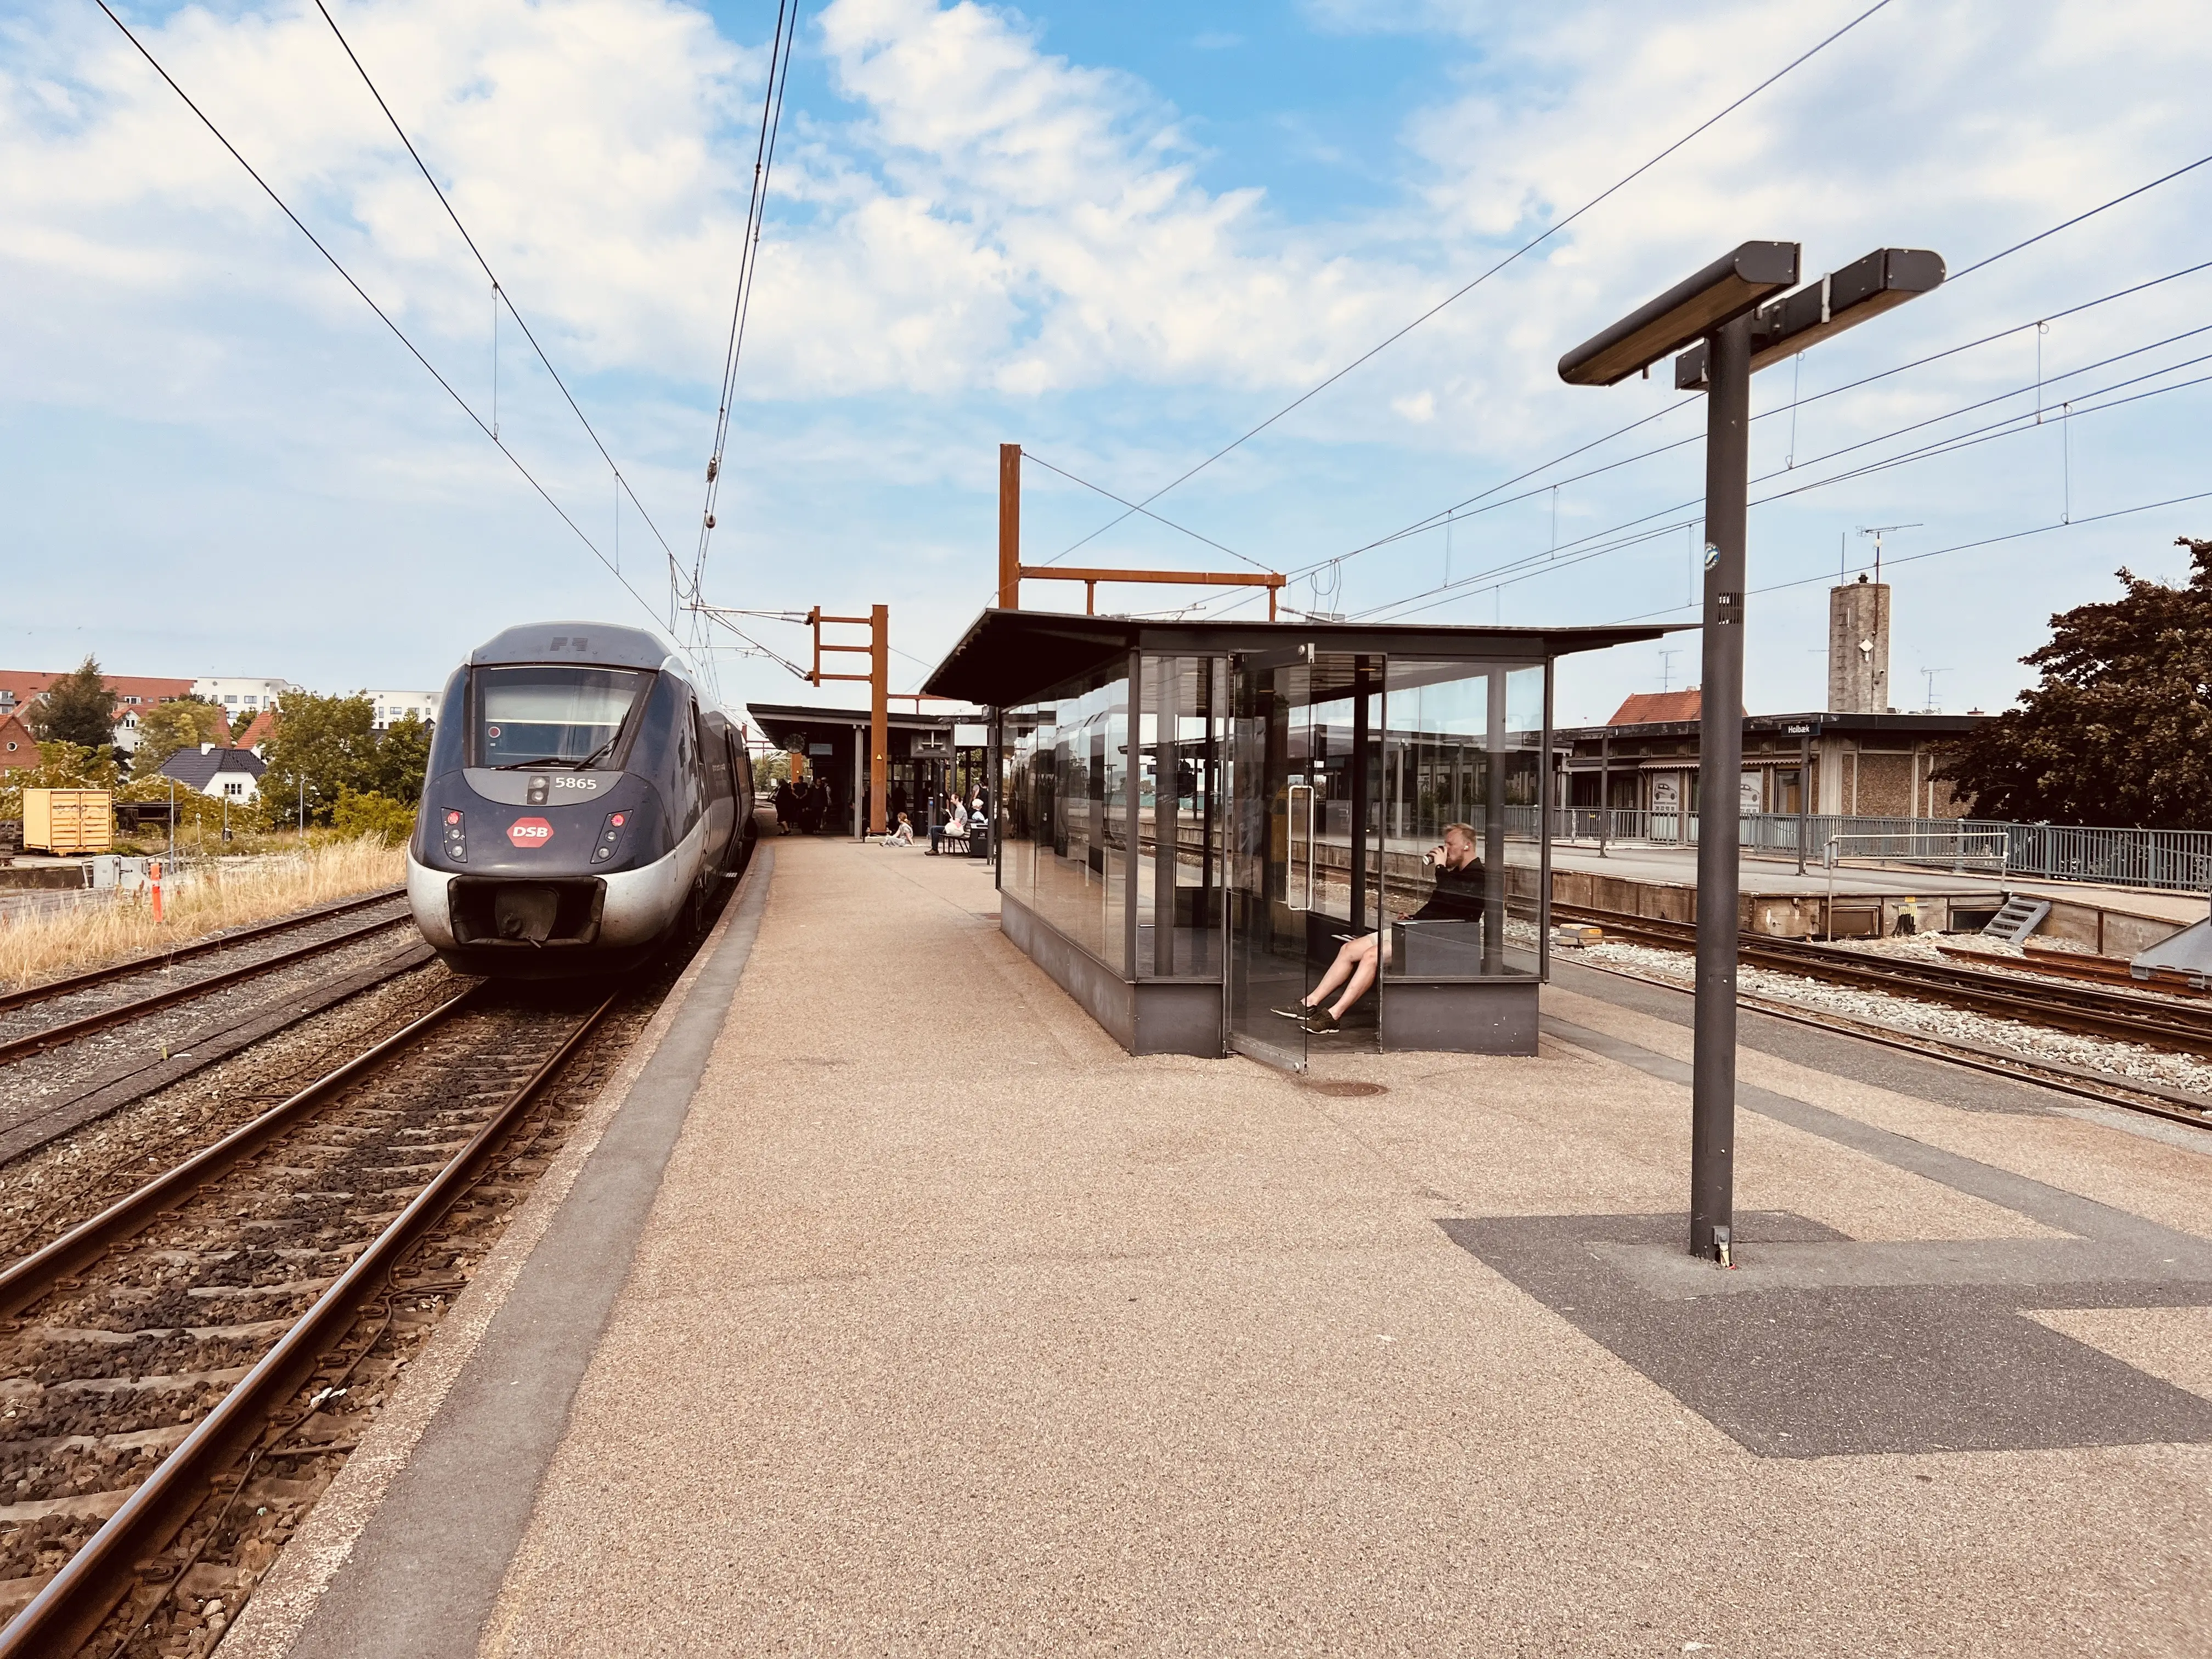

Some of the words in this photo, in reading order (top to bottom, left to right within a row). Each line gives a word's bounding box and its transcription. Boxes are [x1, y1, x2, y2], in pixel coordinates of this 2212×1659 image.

[1788, 724, 1810, 733] Holbæk
[555, 777, 597, 789] 5865
[512, 826, 548, 838] DSB
